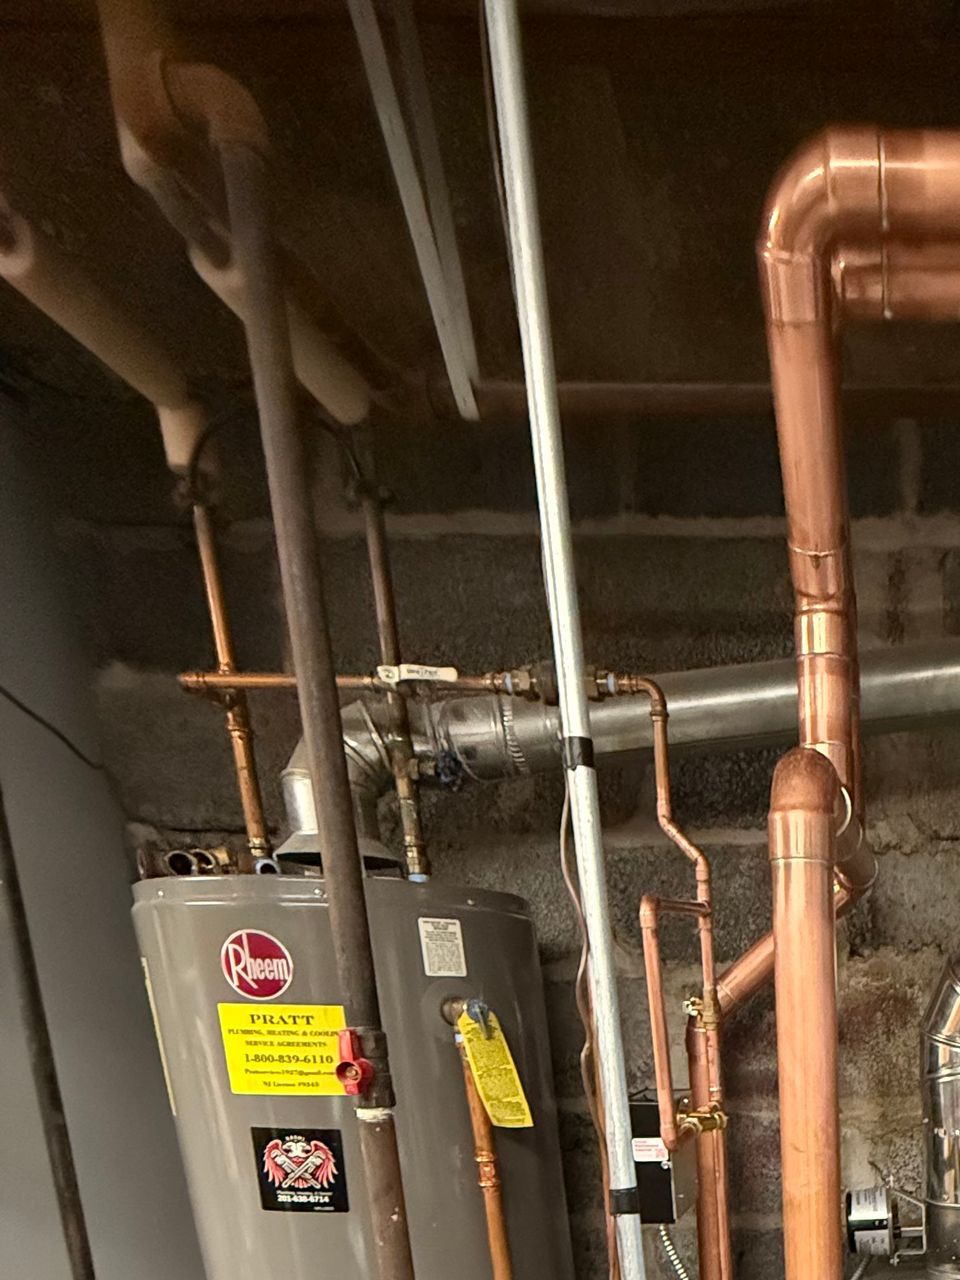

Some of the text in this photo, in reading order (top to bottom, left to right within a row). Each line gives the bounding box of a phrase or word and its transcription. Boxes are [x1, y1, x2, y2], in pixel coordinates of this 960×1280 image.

[228, 931, 288, 989] Rheem
[250, 1014, 314, 1025] PRATT
[245, 1054, 334, 1064] 1-800-839-6110
